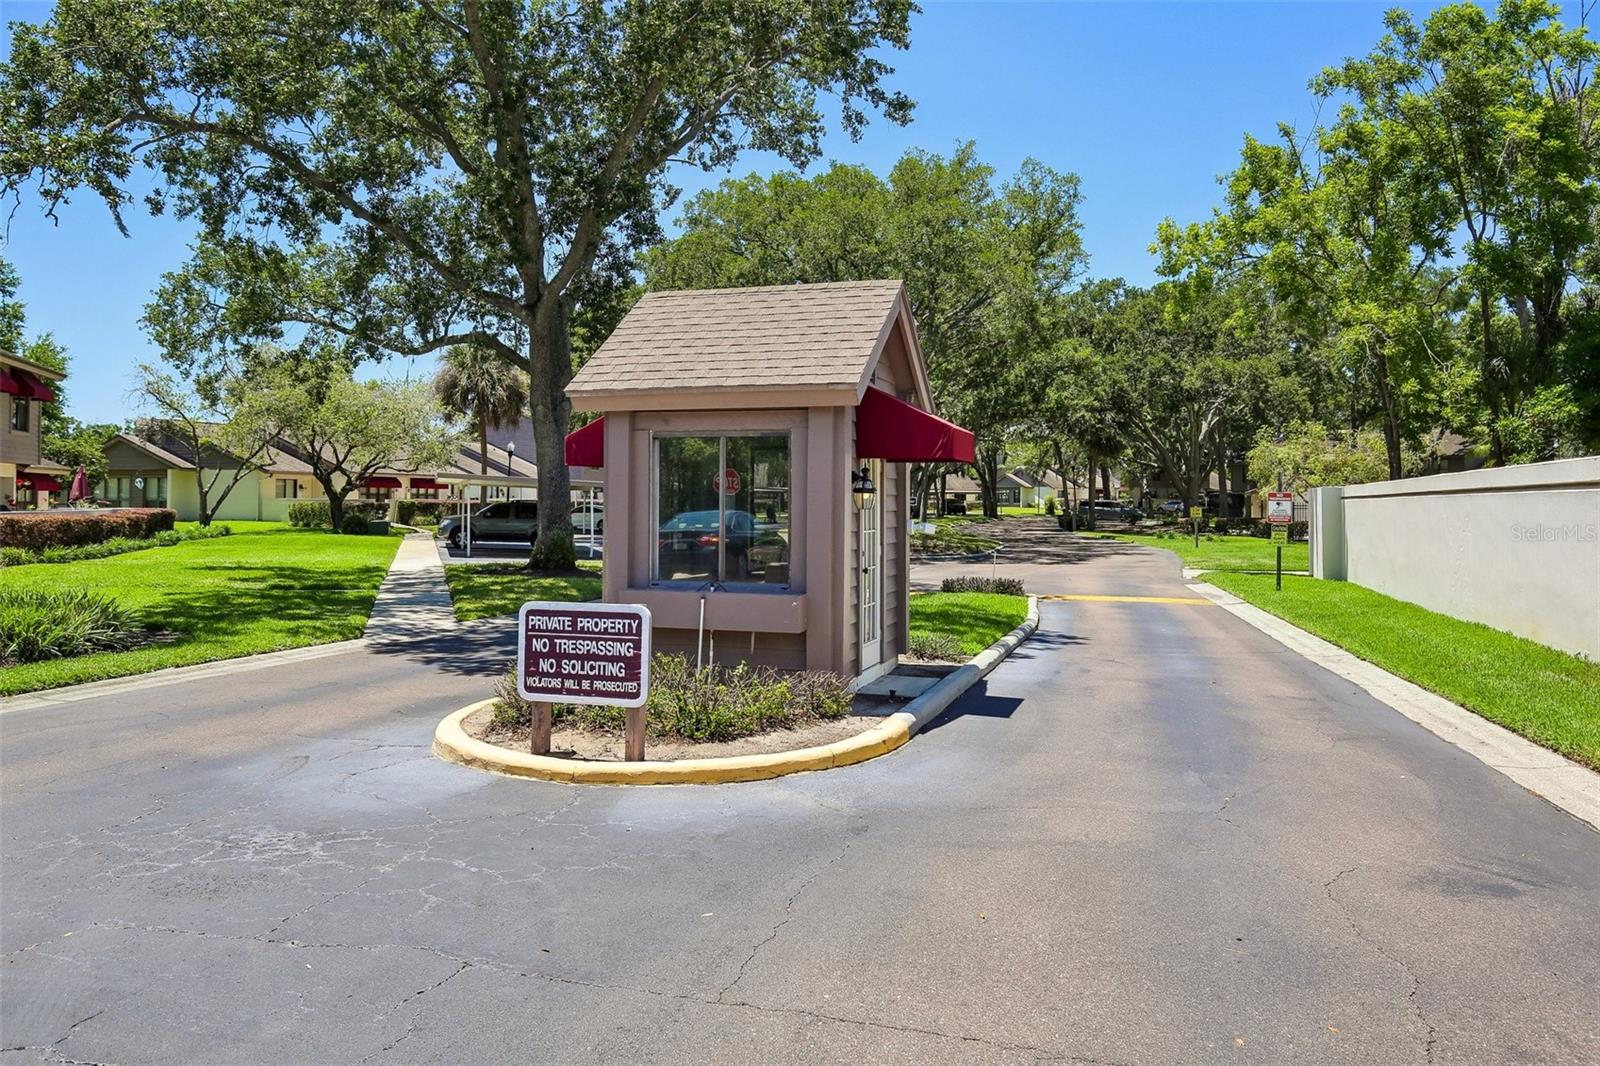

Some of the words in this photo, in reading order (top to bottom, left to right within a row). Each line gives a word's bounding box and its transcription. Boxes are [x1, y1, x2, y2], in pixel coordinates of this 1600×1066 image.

[528, 616, 572, 631] PRIVATE
[577, 618, 639, 634] PROPERTY
[532, 638, 549, 653] NO
[554, 639, 634, 657] TRESPASSING
[539, 658, 556, 673] NO
[561, 660, 626, 677] SOLICITING
[526, 677, 562, 688] VIOLATORS
[563, 679, 579, 690] WILL
[581, 680, 591, 690] BE
[593, 680, 638, 693] PROSECUTED
